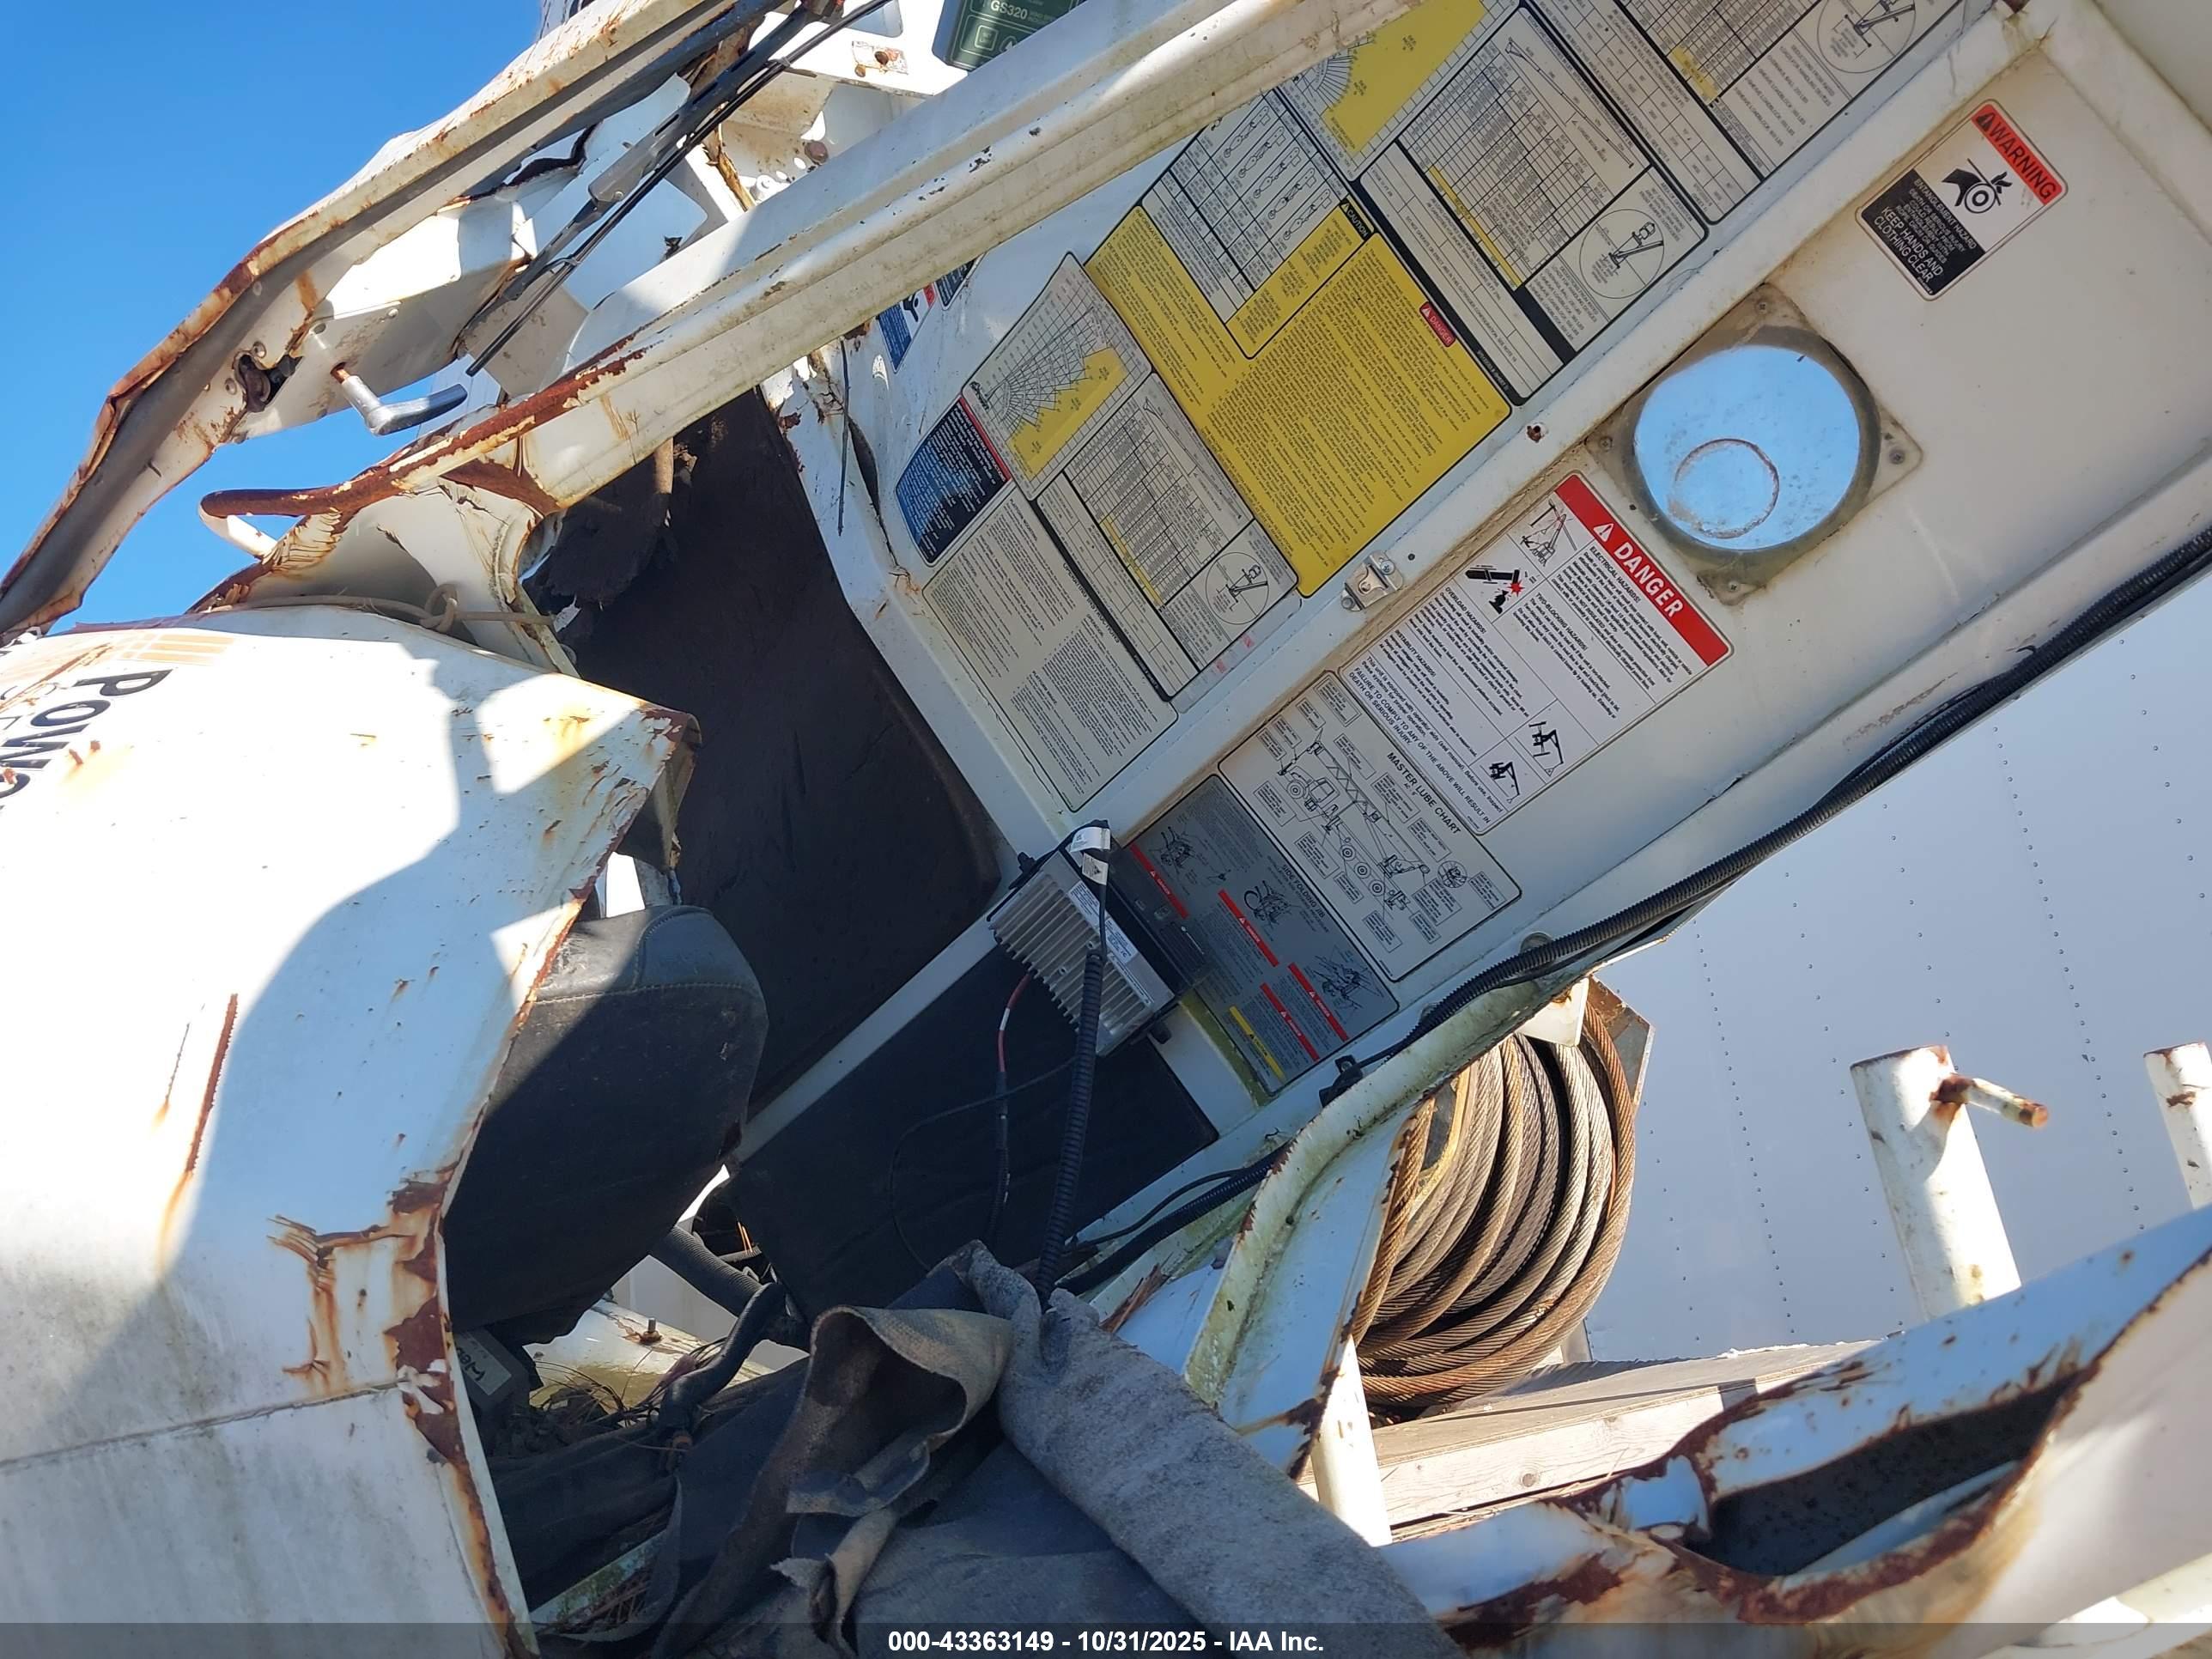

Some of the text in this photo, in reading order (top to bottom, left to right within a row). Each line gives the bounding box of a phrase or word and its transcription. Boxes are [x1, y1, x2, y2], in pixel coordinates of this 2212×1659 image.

[991, 0, 1028, 20] GS320
[1986, 122, 2058, 200] WARNING
[1345, 208, 1370, 238] CAUTION
[1881, 205, 1905, 231] KEEP
[1899, 228, 1929, 259] HANDS
[1923, 254, 1944, 276] AND
[1913, 178, 1977, 250] ENTANGLEMENT HAZARD
[1873, 215, 1911, 258] CLOTHING
[1906, 253, 1934, 283] CLEAR
[1428, 314, 1453, 344] DANGER
[1589, 545, 1641, 604] ELECTRICAL HAZARDS!
[1612, 540, 1685, 618] DANGER
[1443, 586, 1487, 635] OVERLOAD HAZARDS!
[1534, 592, 1588, 652] TWO-BLOCKING HAZARDS!
[1347, 671, 1413, 746] DEATH OR SERIOUS INJURY.
[1352, 666, 1491, 823] FAILURE TO COMPLY TO ANY OF THE ABOVE WILL RESULT IN
[1386, 751, 1461, 836] MASTER LUBE CHART
[1279, 864, 1326, 918] SIDE FOLDING JIB
